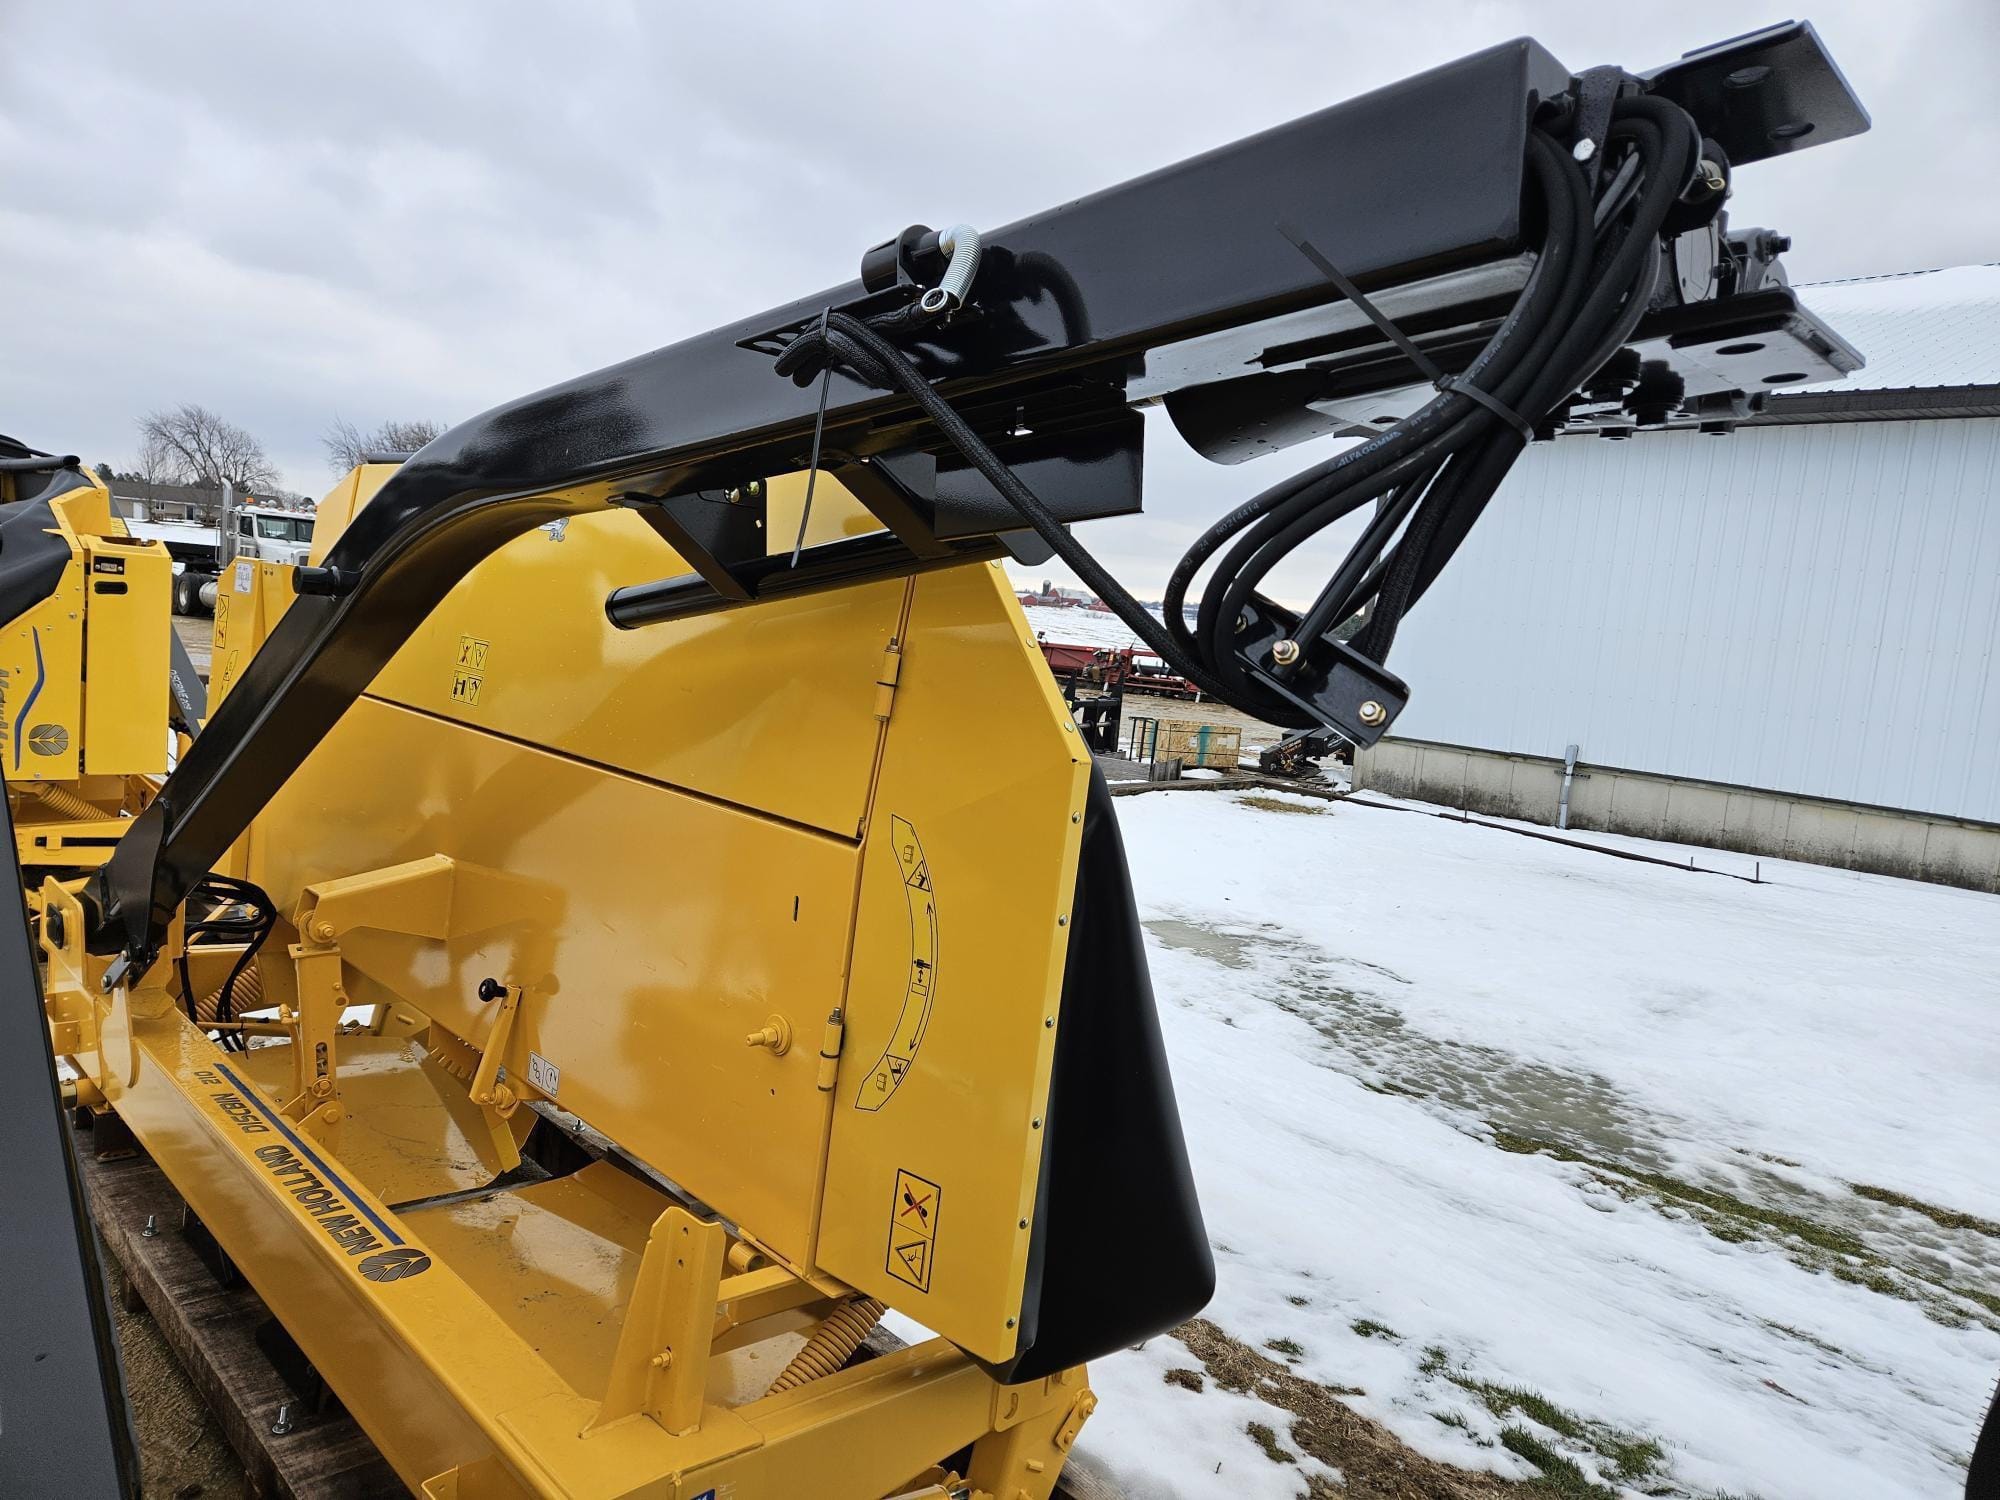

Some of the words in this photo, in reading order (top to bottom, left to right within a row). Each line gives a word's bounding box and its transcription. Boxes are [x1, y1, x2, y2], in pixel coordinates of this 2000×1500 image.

[1336, 431, 1403, 469] ALFAGOMMA
[193, 1070, 223, 1085] 210
[254, 1144, 346, 1217] HOLLAND
[316, 1213, 384, 1256] NEW
